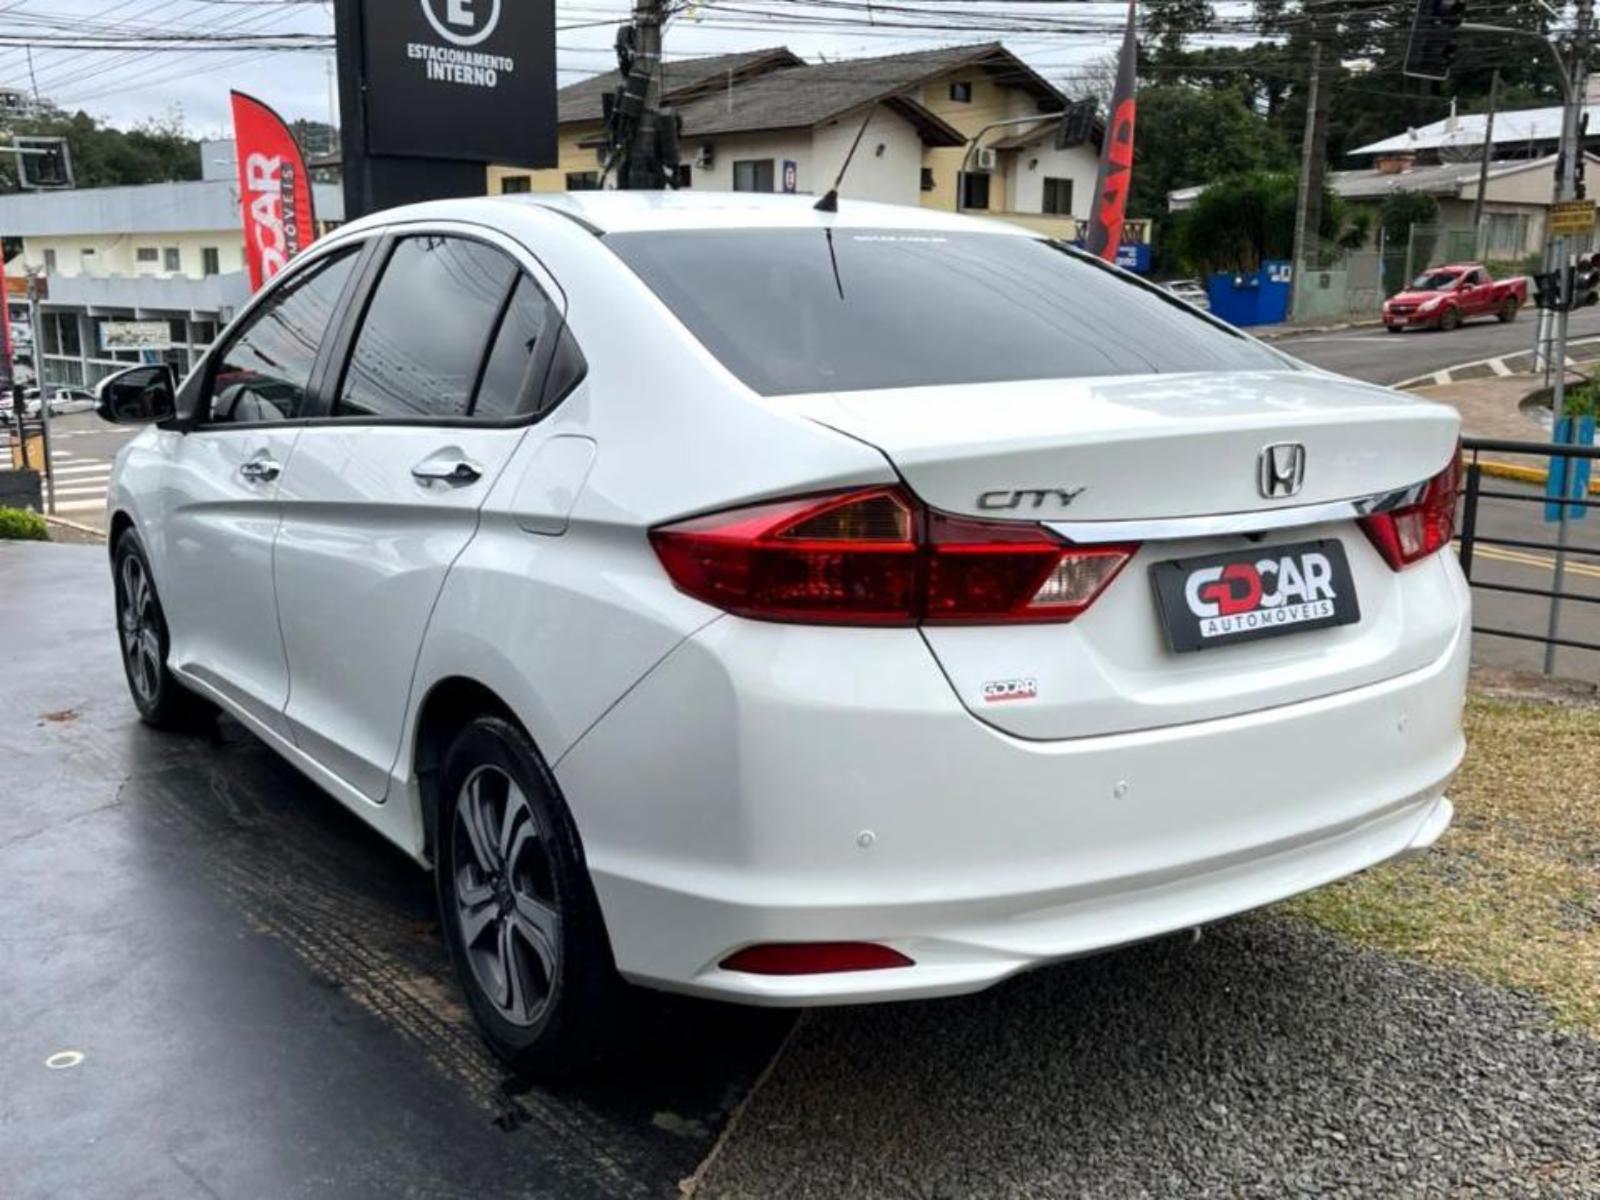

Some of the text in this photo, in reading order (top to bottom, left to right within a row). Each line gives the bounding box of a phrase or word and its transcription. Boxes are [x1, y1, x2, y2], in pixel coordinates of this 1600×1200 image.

[407, 43, 514, 72] ESTACIONAMENTO
[426, 61, 497, 88] INTERNO
[976, 486, 1087, 511] CITY
[1185, 553, 1336, 618] GDCAR
